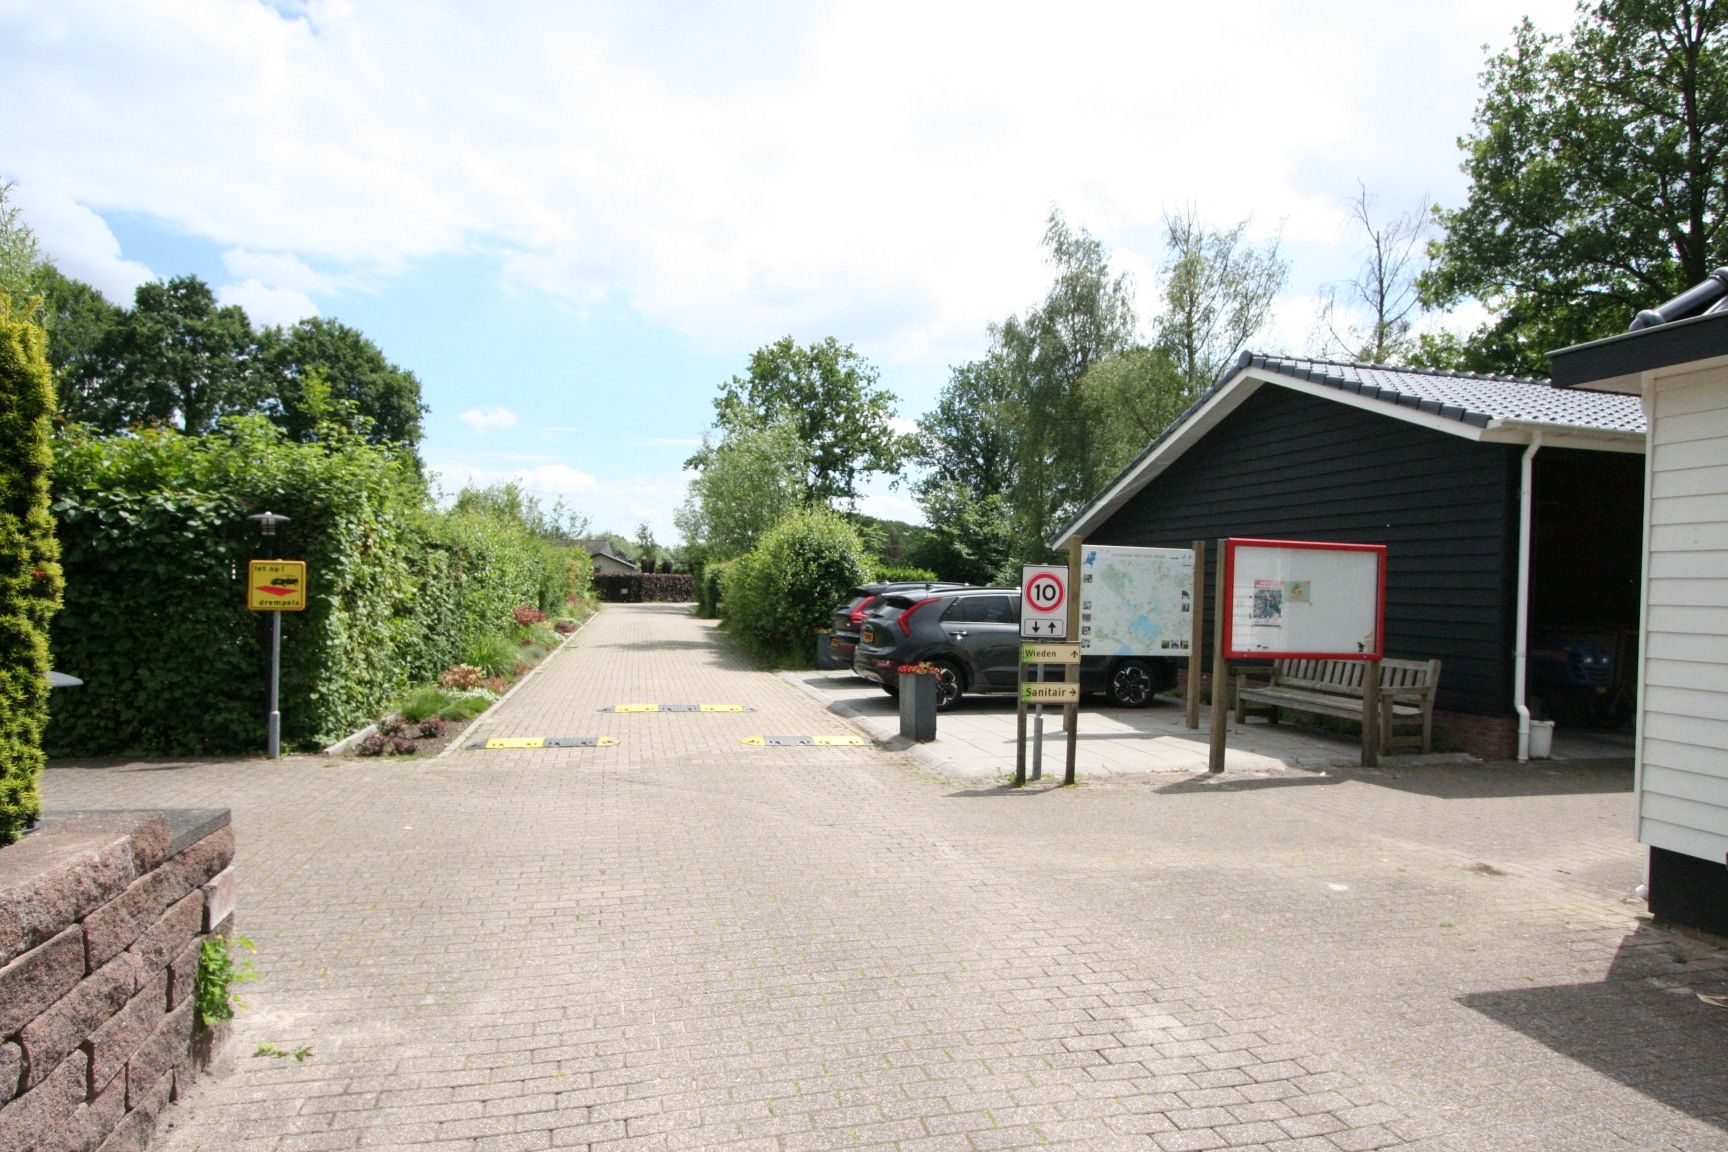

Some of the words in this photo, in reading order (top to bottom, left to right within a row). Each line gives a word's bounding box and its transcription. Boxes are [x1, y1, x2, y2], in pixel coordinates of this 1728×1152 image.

[1034, 584, 1056, 601] 10
[258, 599, 300, 607] drempels
[1025, 646, 1057, 658] Wieden
[1026, 687, 1066, 697] Sanitair
